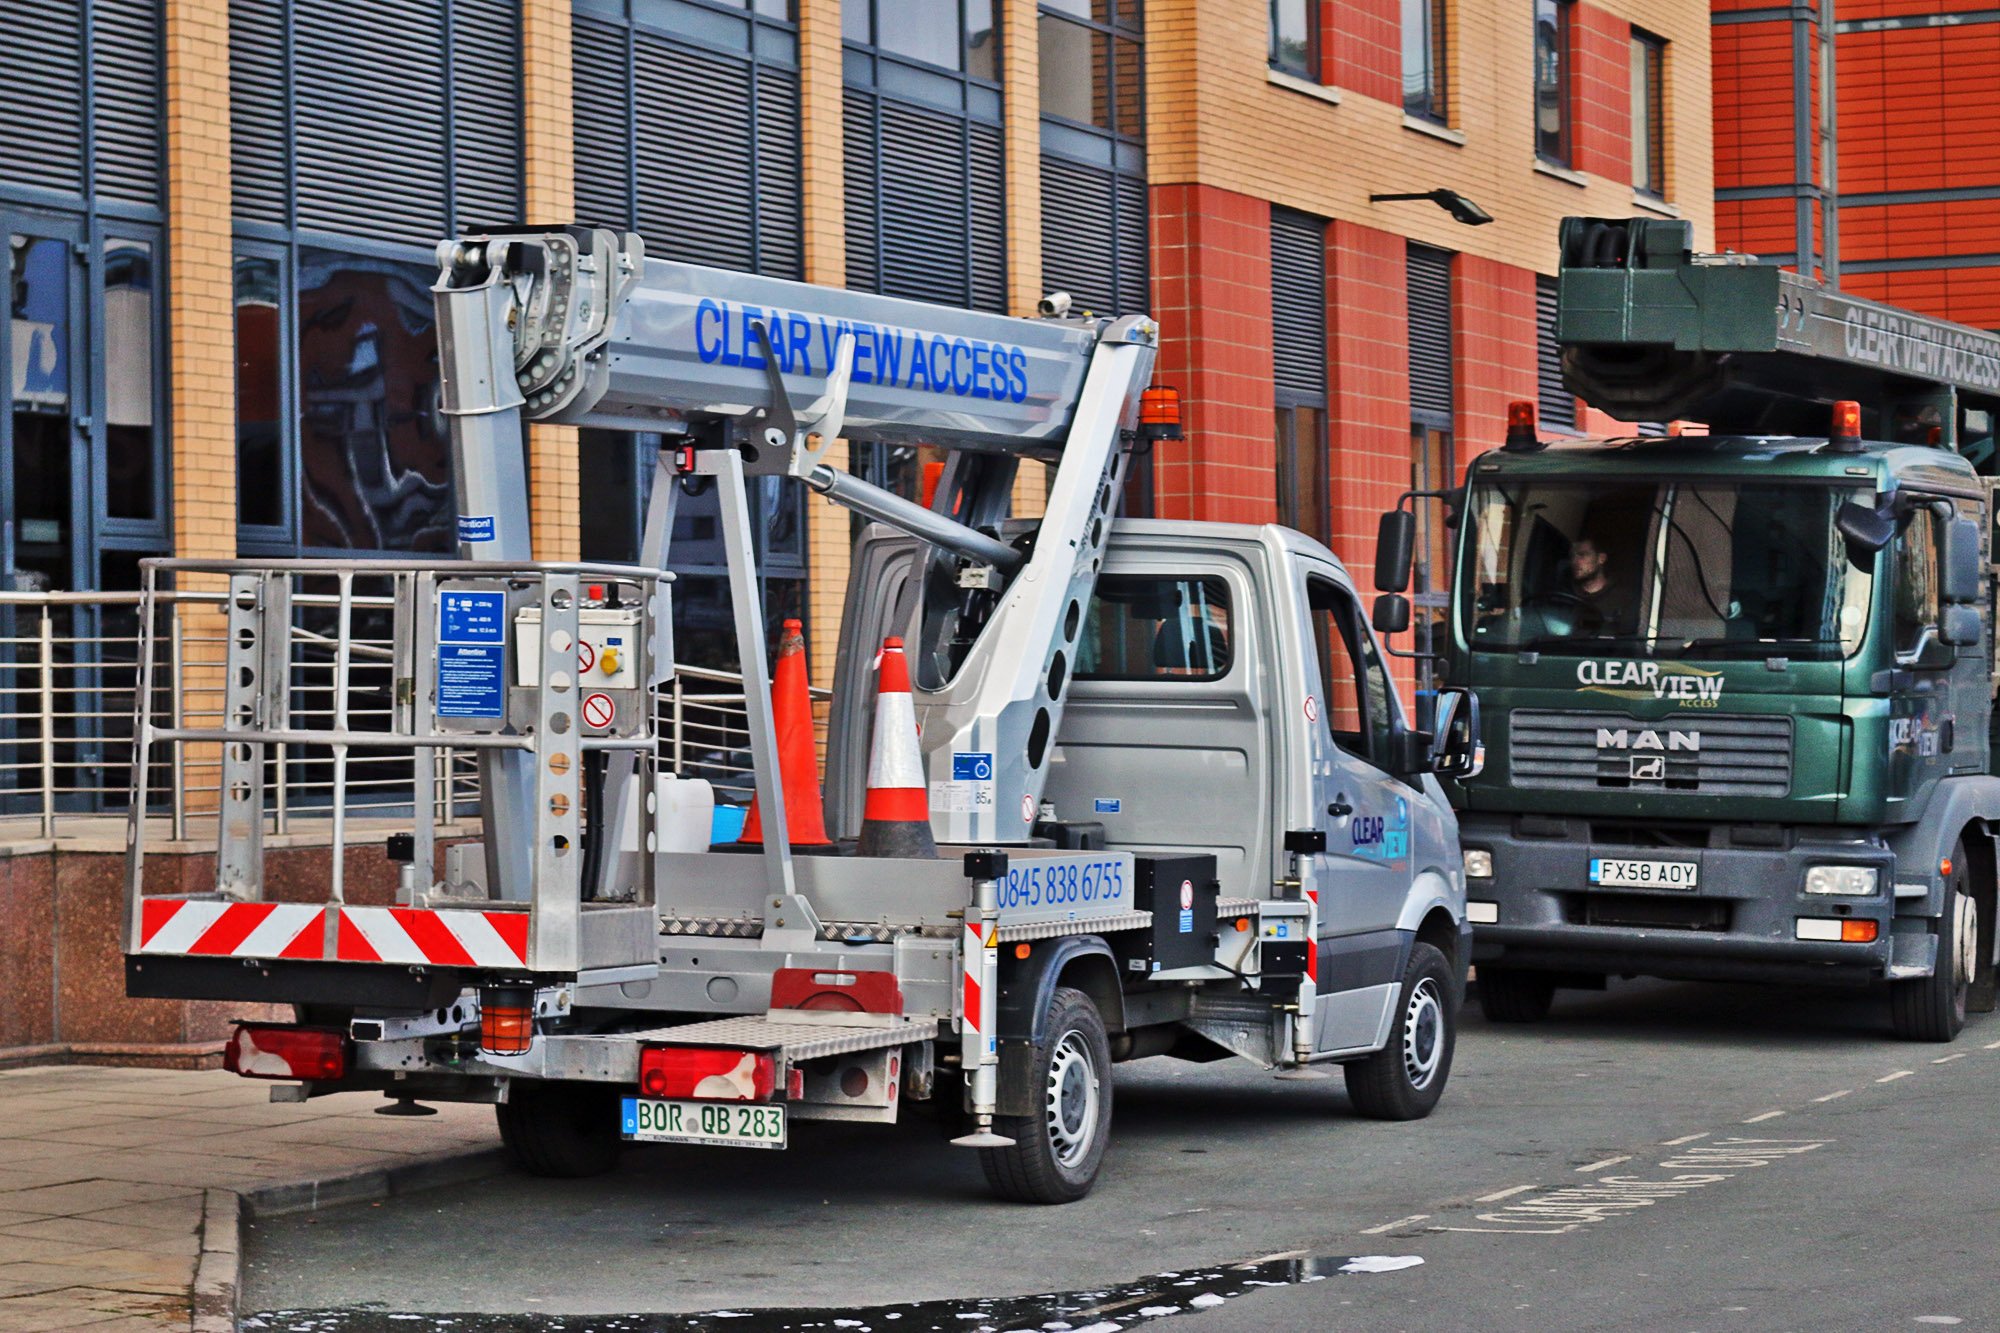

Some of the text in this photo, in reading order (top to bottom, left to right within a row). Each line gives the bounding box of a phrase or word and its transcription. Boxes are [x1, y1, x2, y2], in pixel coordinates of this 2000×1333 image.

[695, 298, 811, 376] CLEAR
[906, 332, 1027, 403] ACCESS
[1845, 306, 2000, 388] CLEAR VIEW ACCESS
[1577, 660, 1660, 685] CLEAR
[1651, 675, 1725, 700] VIEW
[1678, 699, 1718, 708] ACCESS
[1597, 728, 1700, 751] MAN
[1352, 816, 1385, 845] CLEAR
[997, 862, 1122, 908] 0845 838 6755
[1602, 862, 1694, 883] FX58 AOY
[627, 1102, 780, 1138] D BOR QB 283
[1427, 1137, 1837, 1234] LOADING ONLY
